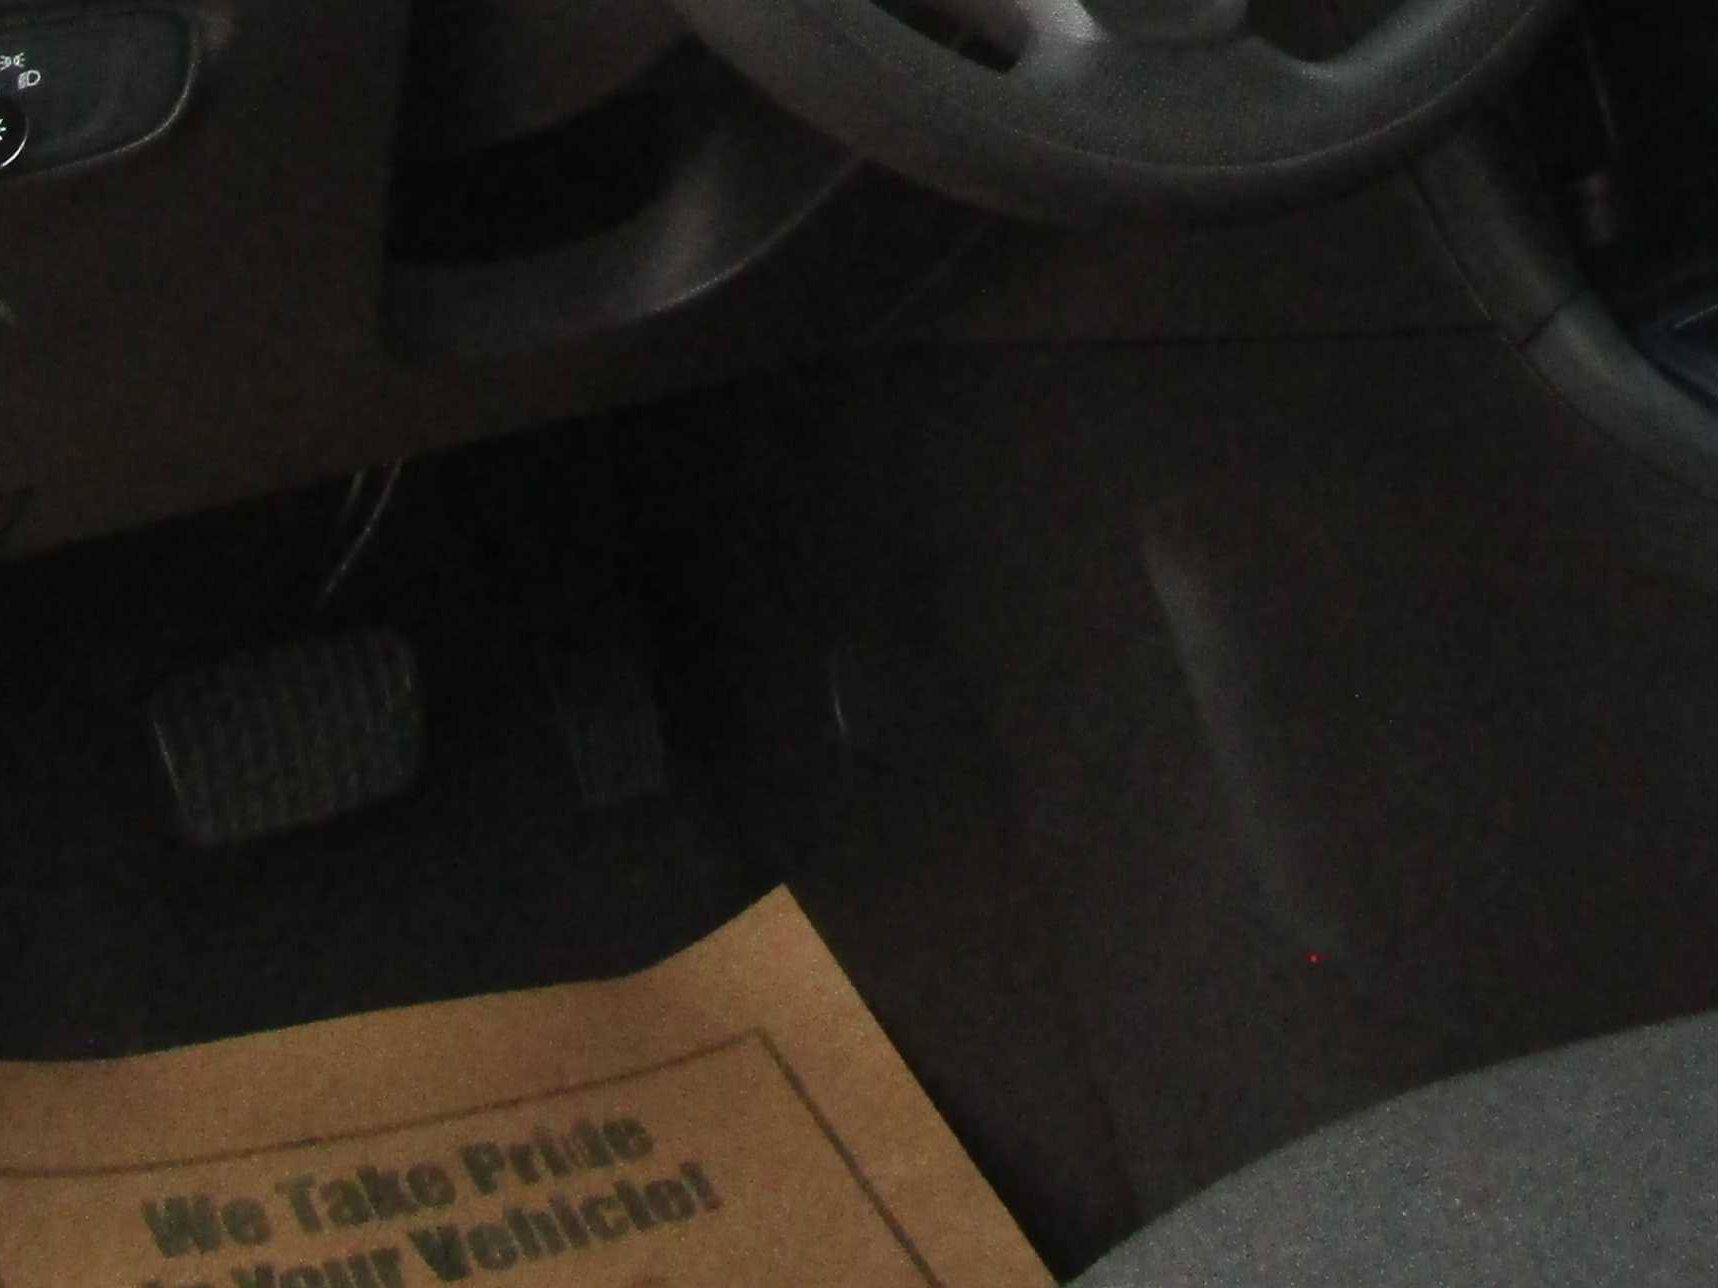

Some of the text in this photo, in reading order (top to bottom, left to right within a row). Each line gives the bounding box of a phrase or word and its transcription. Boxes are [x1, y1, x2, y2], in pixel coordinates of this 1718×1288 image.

[141, 1117, 655, 1259] We Take Pride
[408, 1161, 722, 1283] Vehicle!
